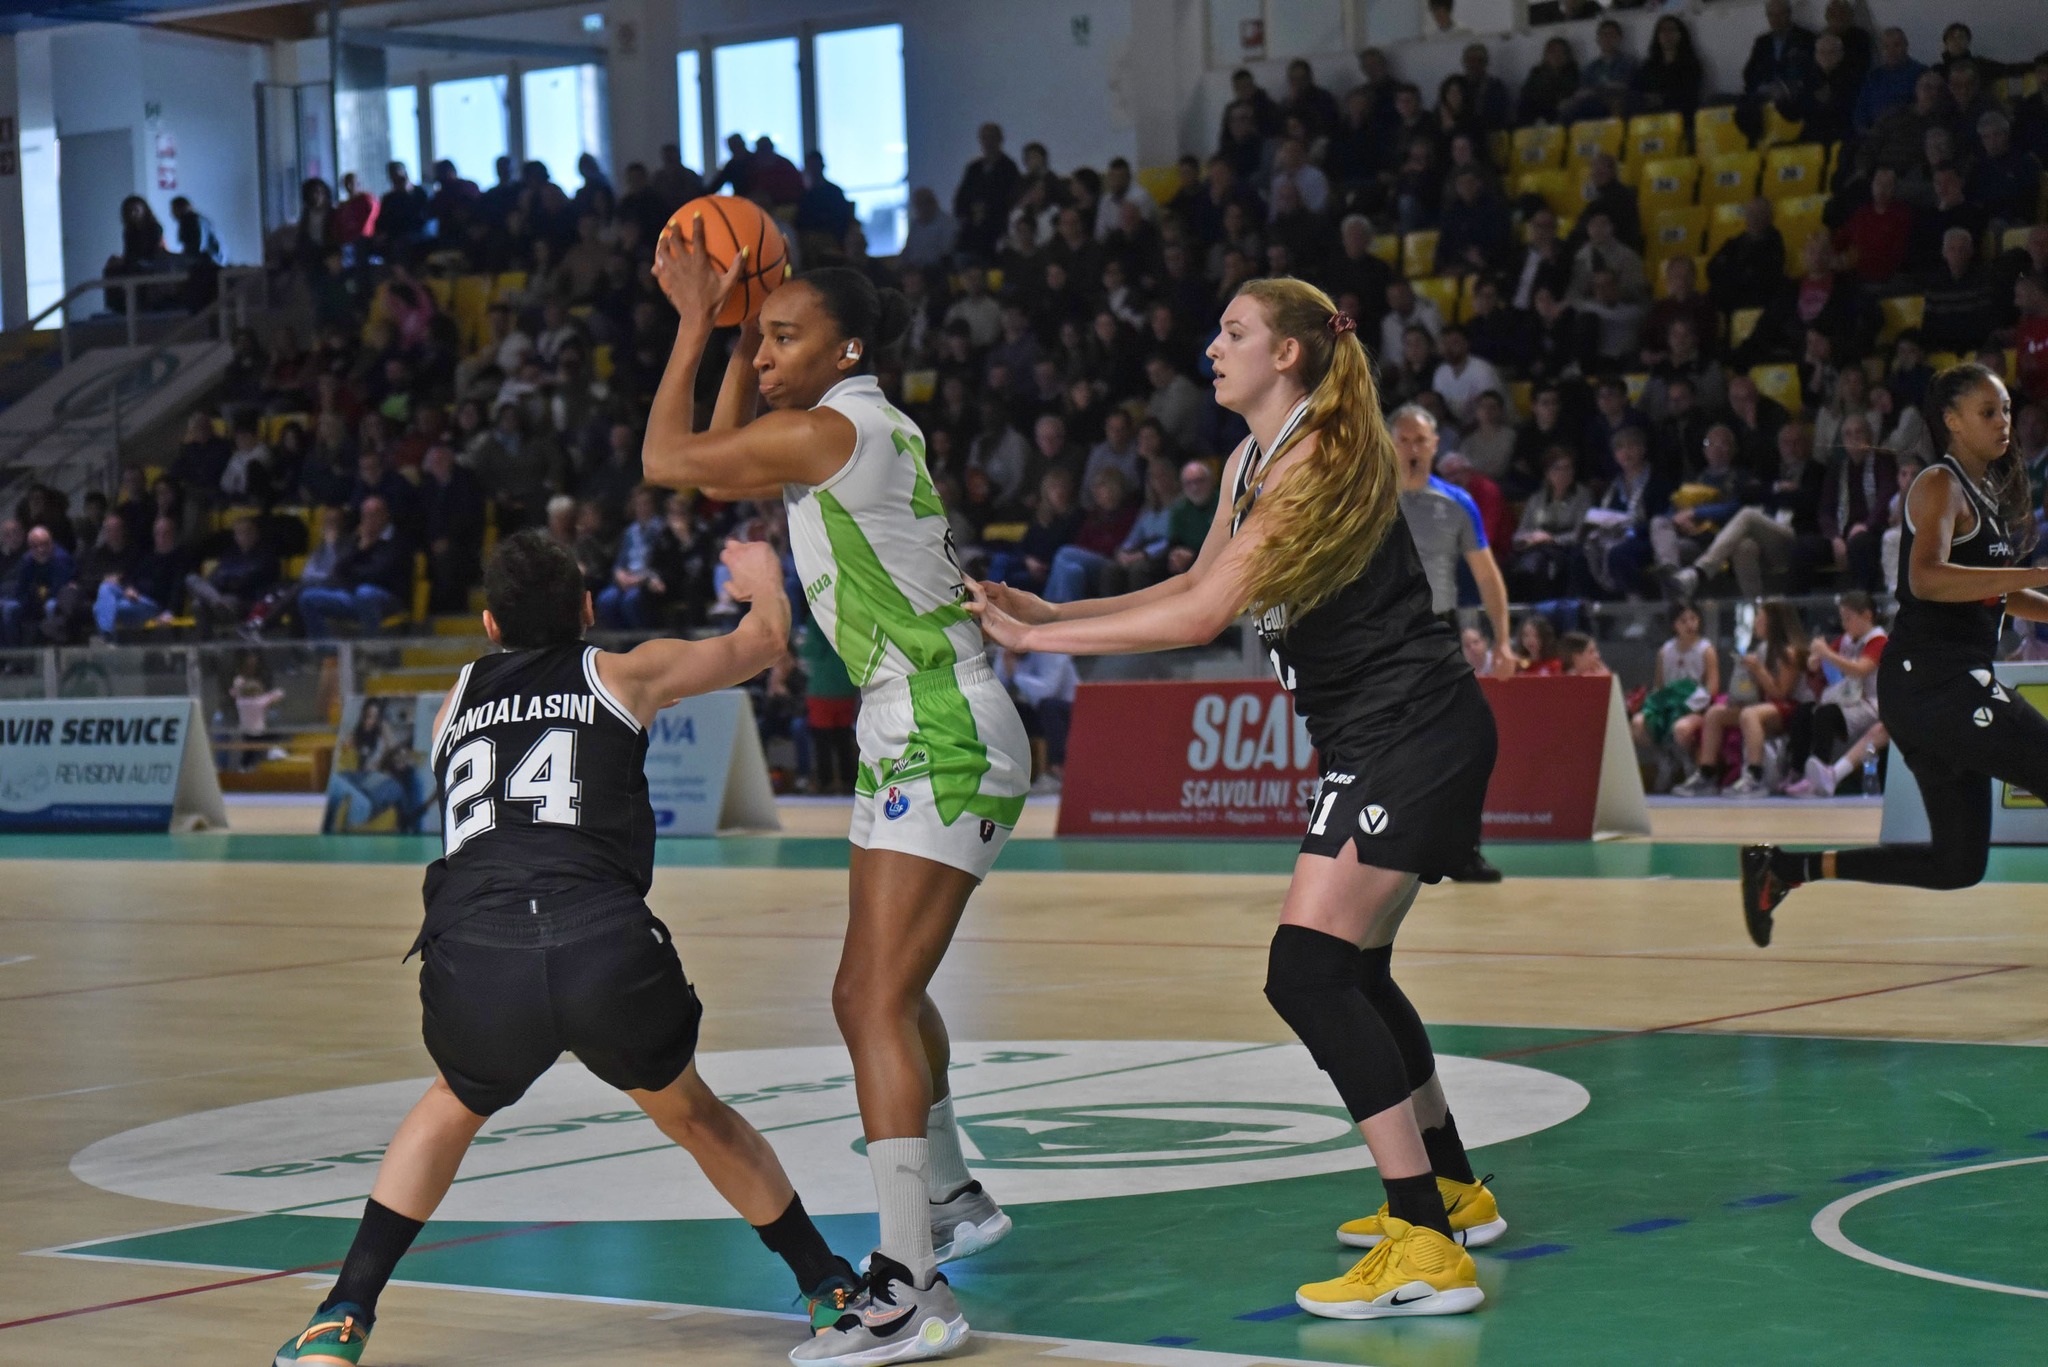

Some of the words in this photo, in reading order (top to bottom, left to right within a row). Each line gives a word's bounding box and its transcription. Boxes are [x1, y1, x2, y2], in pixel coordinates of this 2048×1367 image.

[807, 573, 833, 606] qua
[60, 717, 180, 745] SERVICE
[1187, 694, 1314, 771] SCAV
[128, 763, 173, 785] AUTO
[1326, 771, 1356, 784] ARS
[444, 728, 582, 857] 24
[1181, 780, 1291, 808] SCAVOLINI
